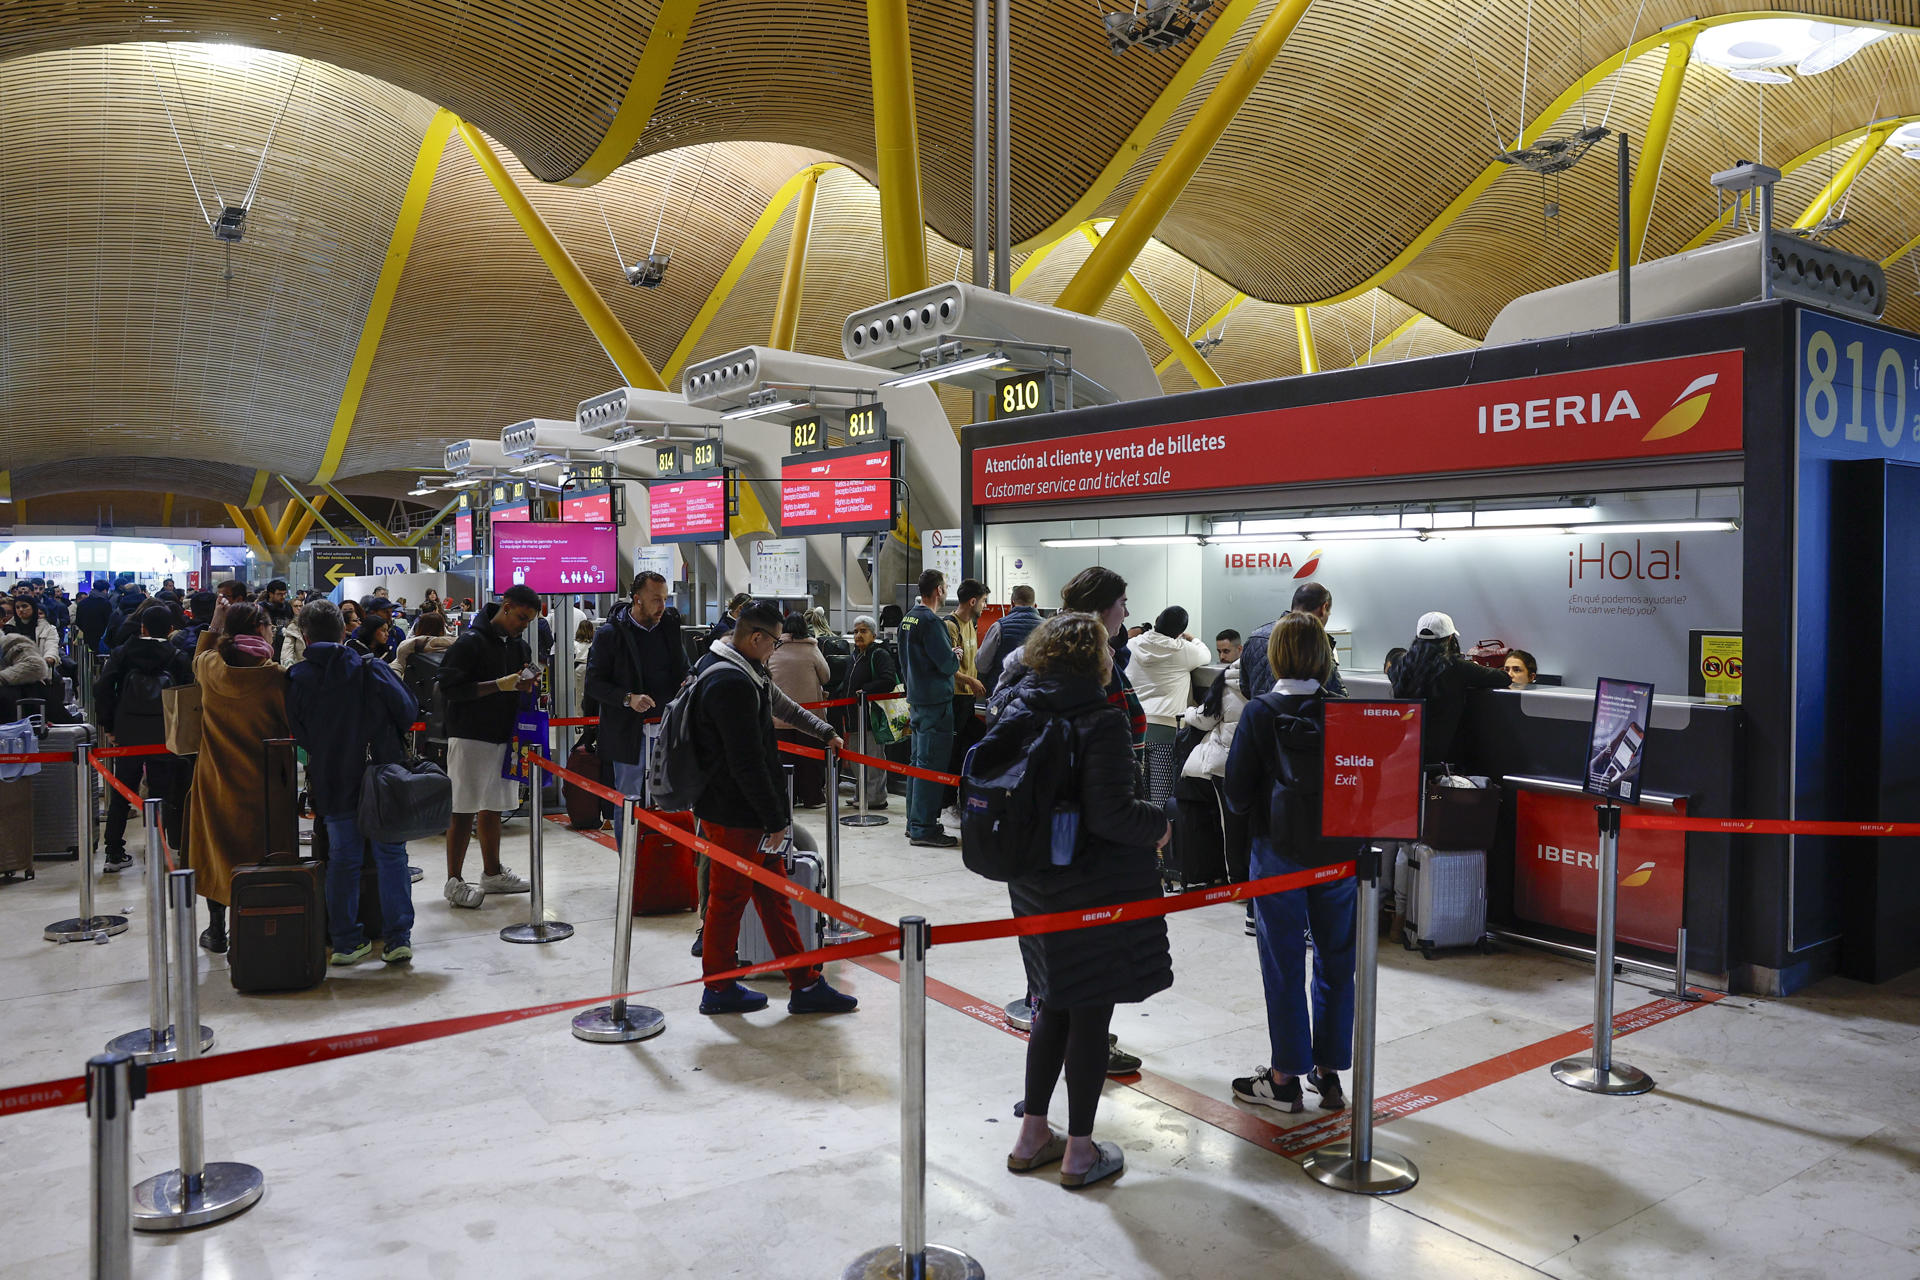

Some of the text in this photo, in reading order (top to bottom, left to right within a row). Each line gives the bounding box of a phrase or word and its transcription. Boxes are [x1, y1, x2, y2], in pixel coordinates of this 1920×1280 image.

[1002, 380, 1040, 414] 810
[1806, 330, 1906, 447] 810
[1478, 389, 1641, 434] IBERIA
[849, 410, 874, 437] 811
[794, 422, 816, 447] 812
[659, 452, 674, 471] 814
[695, 444, 712, 465] 813
[985, 434, 1226, 474] Atención al cliente y venta de billetes
[985, 466, 1171, 498] Customer service and ticket sale
[39, 555, 69, 567] CASH
[1225, 552, 1292, 568] IBERIA
[1569, 539, 1680, 588] ¡Hola!
[1568, 594, 1687, 605] ¿En qué podemos ayudarle?
[1617, 606, 1635, 616] help
[1637, 607, 1657, 616] you?
[1335, 755, 1374, 767] Salida
[1334, 774, 1358, 785] Exit
[1537, 844, 1602, 870] IBERI
[1314, 869, 1339, 879] IBERIA
[1205, 890, 1232, 901] IBERIA
[1082, 911, 1111, 922] IBERIA
[328, 1035, 379, 1050] IBERIA
[1390, 1090, 1420, 1106] HERE
[1391, 1095, 1439, 1113] TURNO
